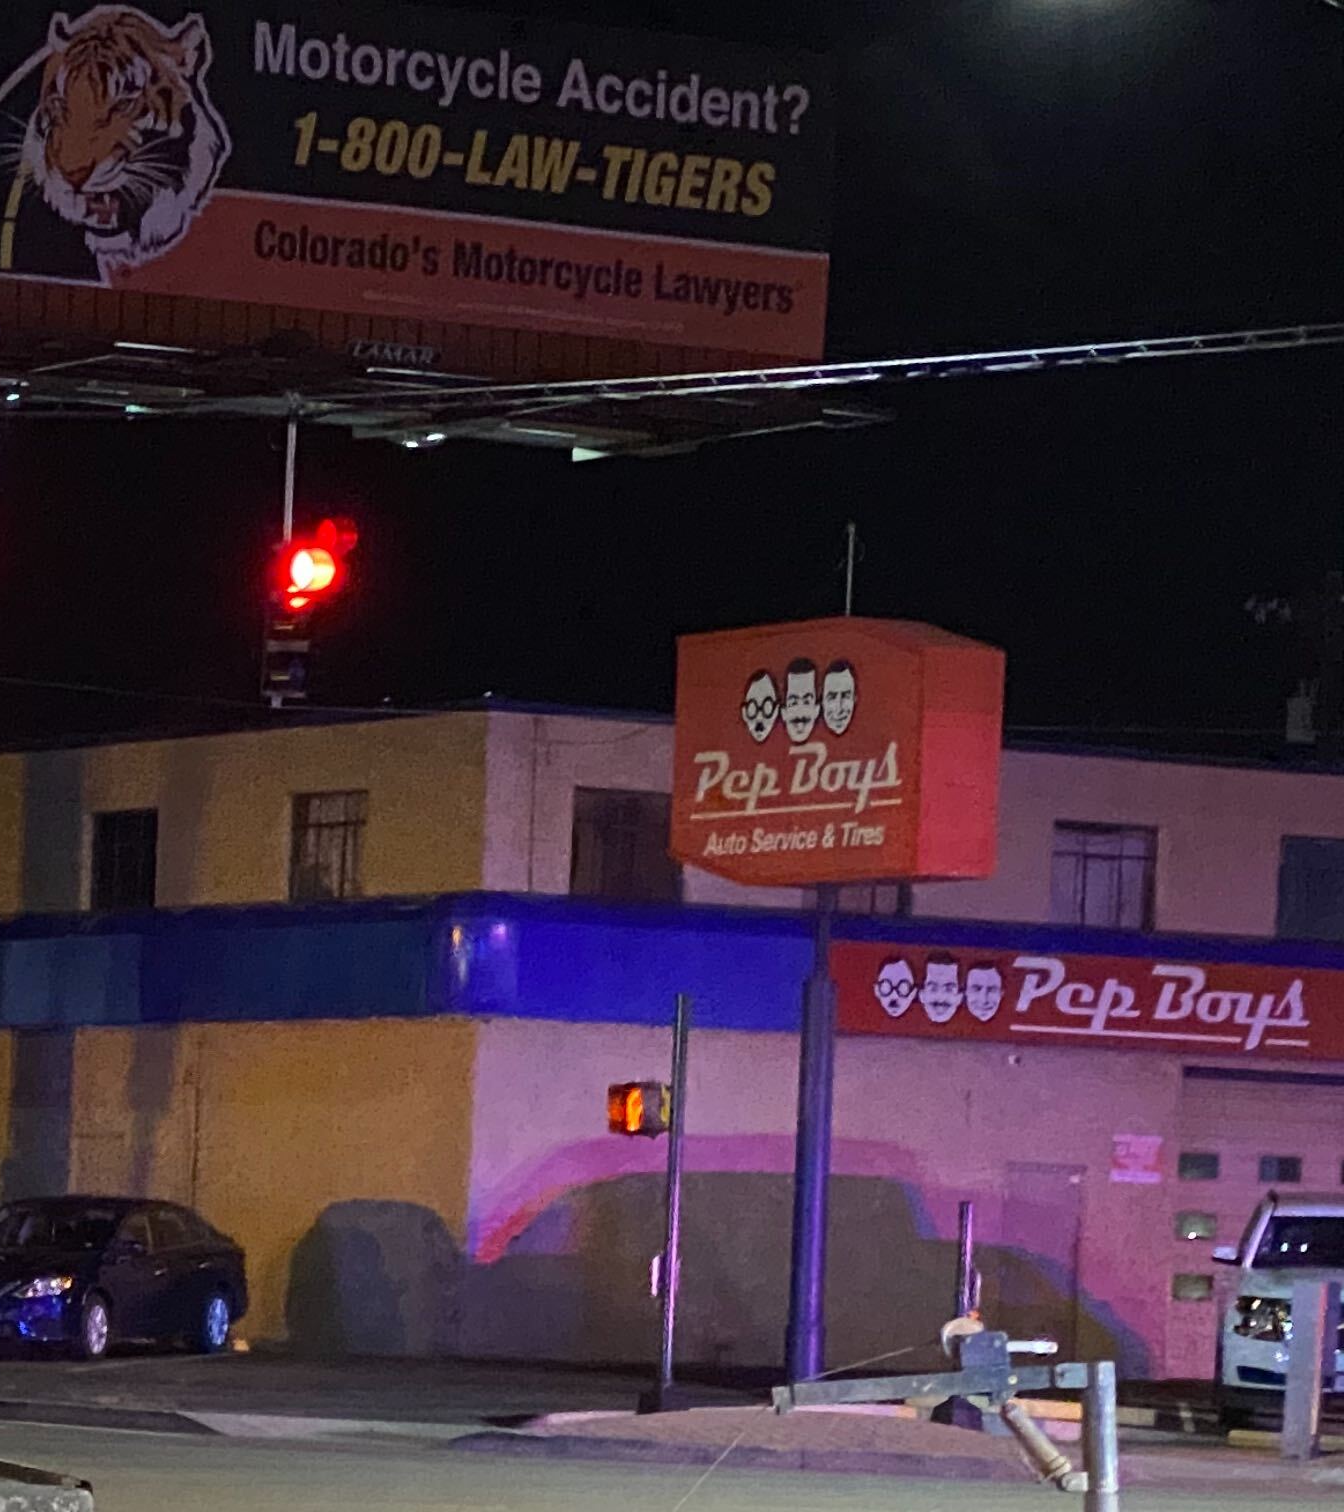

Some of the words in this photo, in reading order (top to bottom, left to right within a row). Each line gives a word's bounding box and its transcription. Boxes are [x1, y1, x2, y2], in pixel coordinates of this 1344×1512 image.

[253, 20, 542, 108] Motorcycle
[556, 58, 810, 135] Accident?
[293, 111, 777, 218] 1-800-LAW-TIGERS
[254, 219, 439, 277] Colorado's
[452, 241, 643, 298] Motorcycle
[654, 264, 794, 318] Lawyers
[693, 751, 782, 815] Pep
[788, 741, 903, 814] Boys
[703, 831, 746, 857] Auto
[750, 825, 818, 854] Service
[821, 822, 836, 849] &
[841, 821, 885, 847] Tires
[1012, 956, 1141, 1032] Pep
[1151, 964, 1310, 1050] Boys
